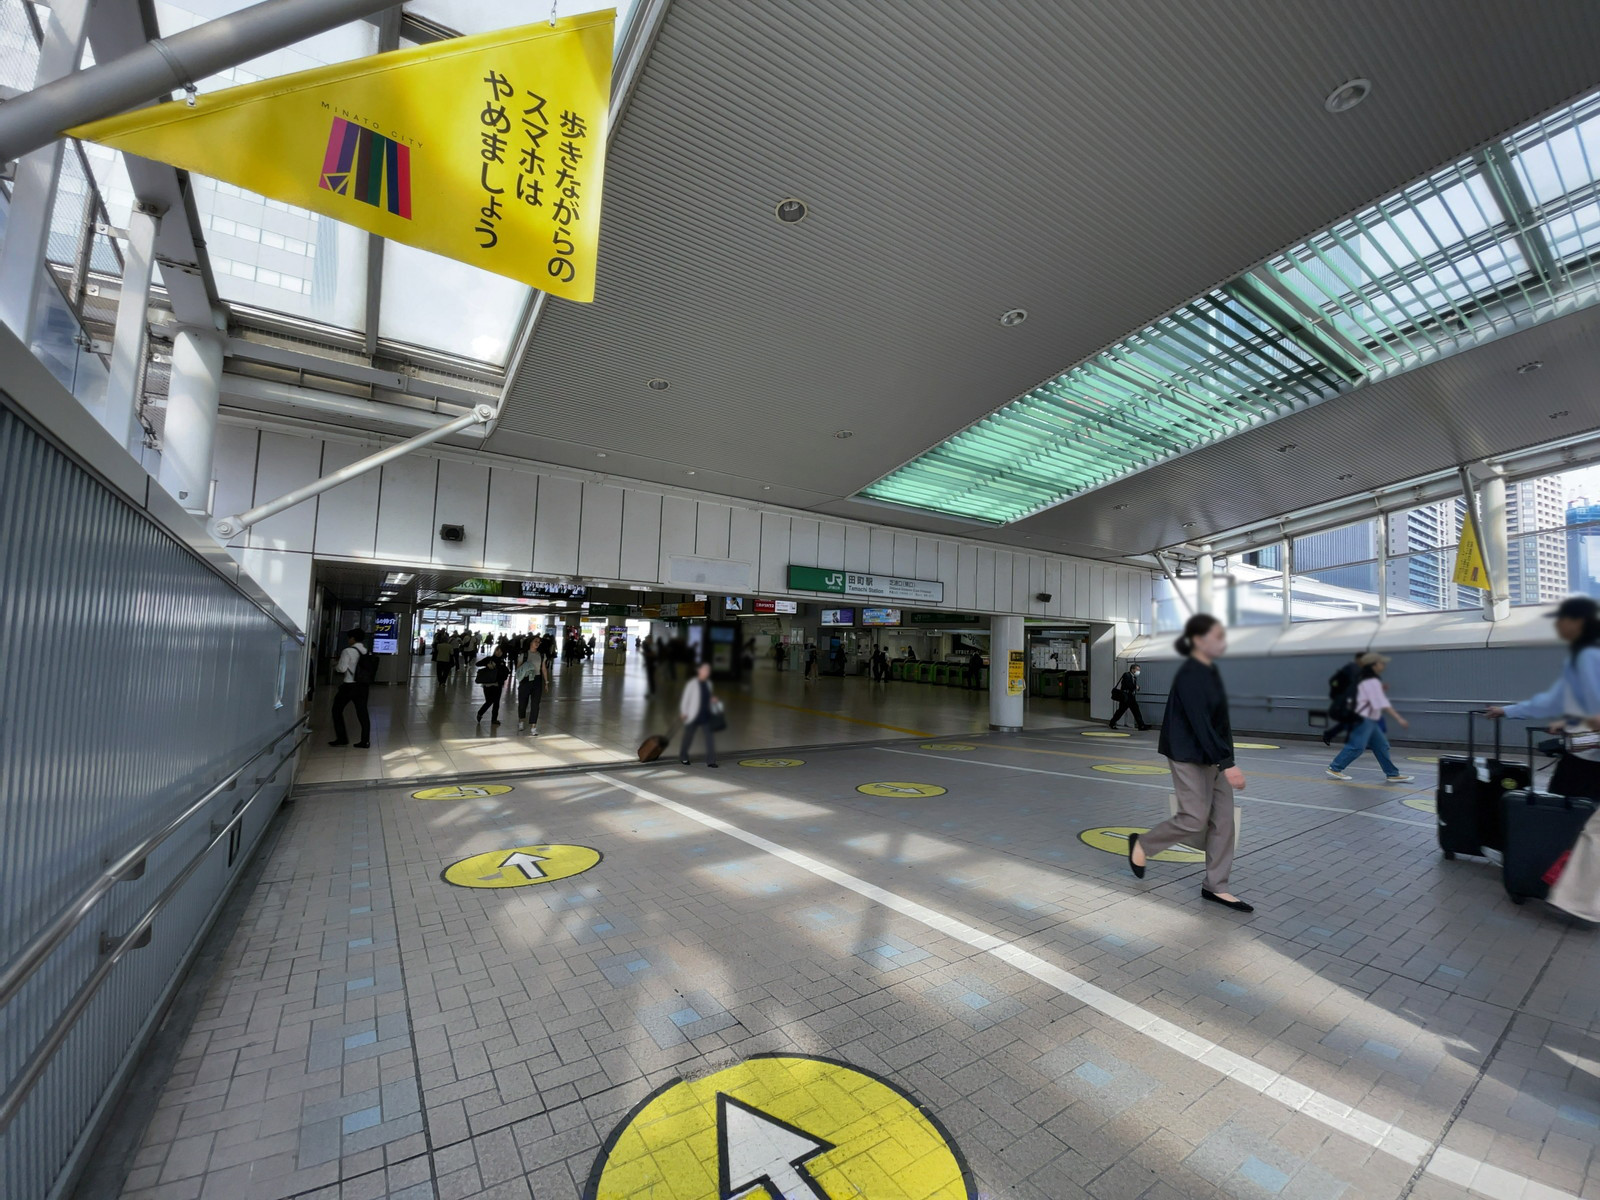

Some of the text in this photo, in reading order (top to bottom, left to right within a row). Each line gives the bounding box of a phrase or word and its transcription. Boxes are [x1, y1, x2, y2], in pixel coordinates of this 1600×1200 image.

[321, 101, 423, 148] MINATO CITY
[475, 70, 514, 248] やめましょう
[516, 90, 549, 207] スマホは
[547, 109, 587, 283] 歩きながらの
[825, 573, 843, 586] JR
[848, 575, 873, 587] 田町駅
[848, 585, 868, 593] Tamachi
